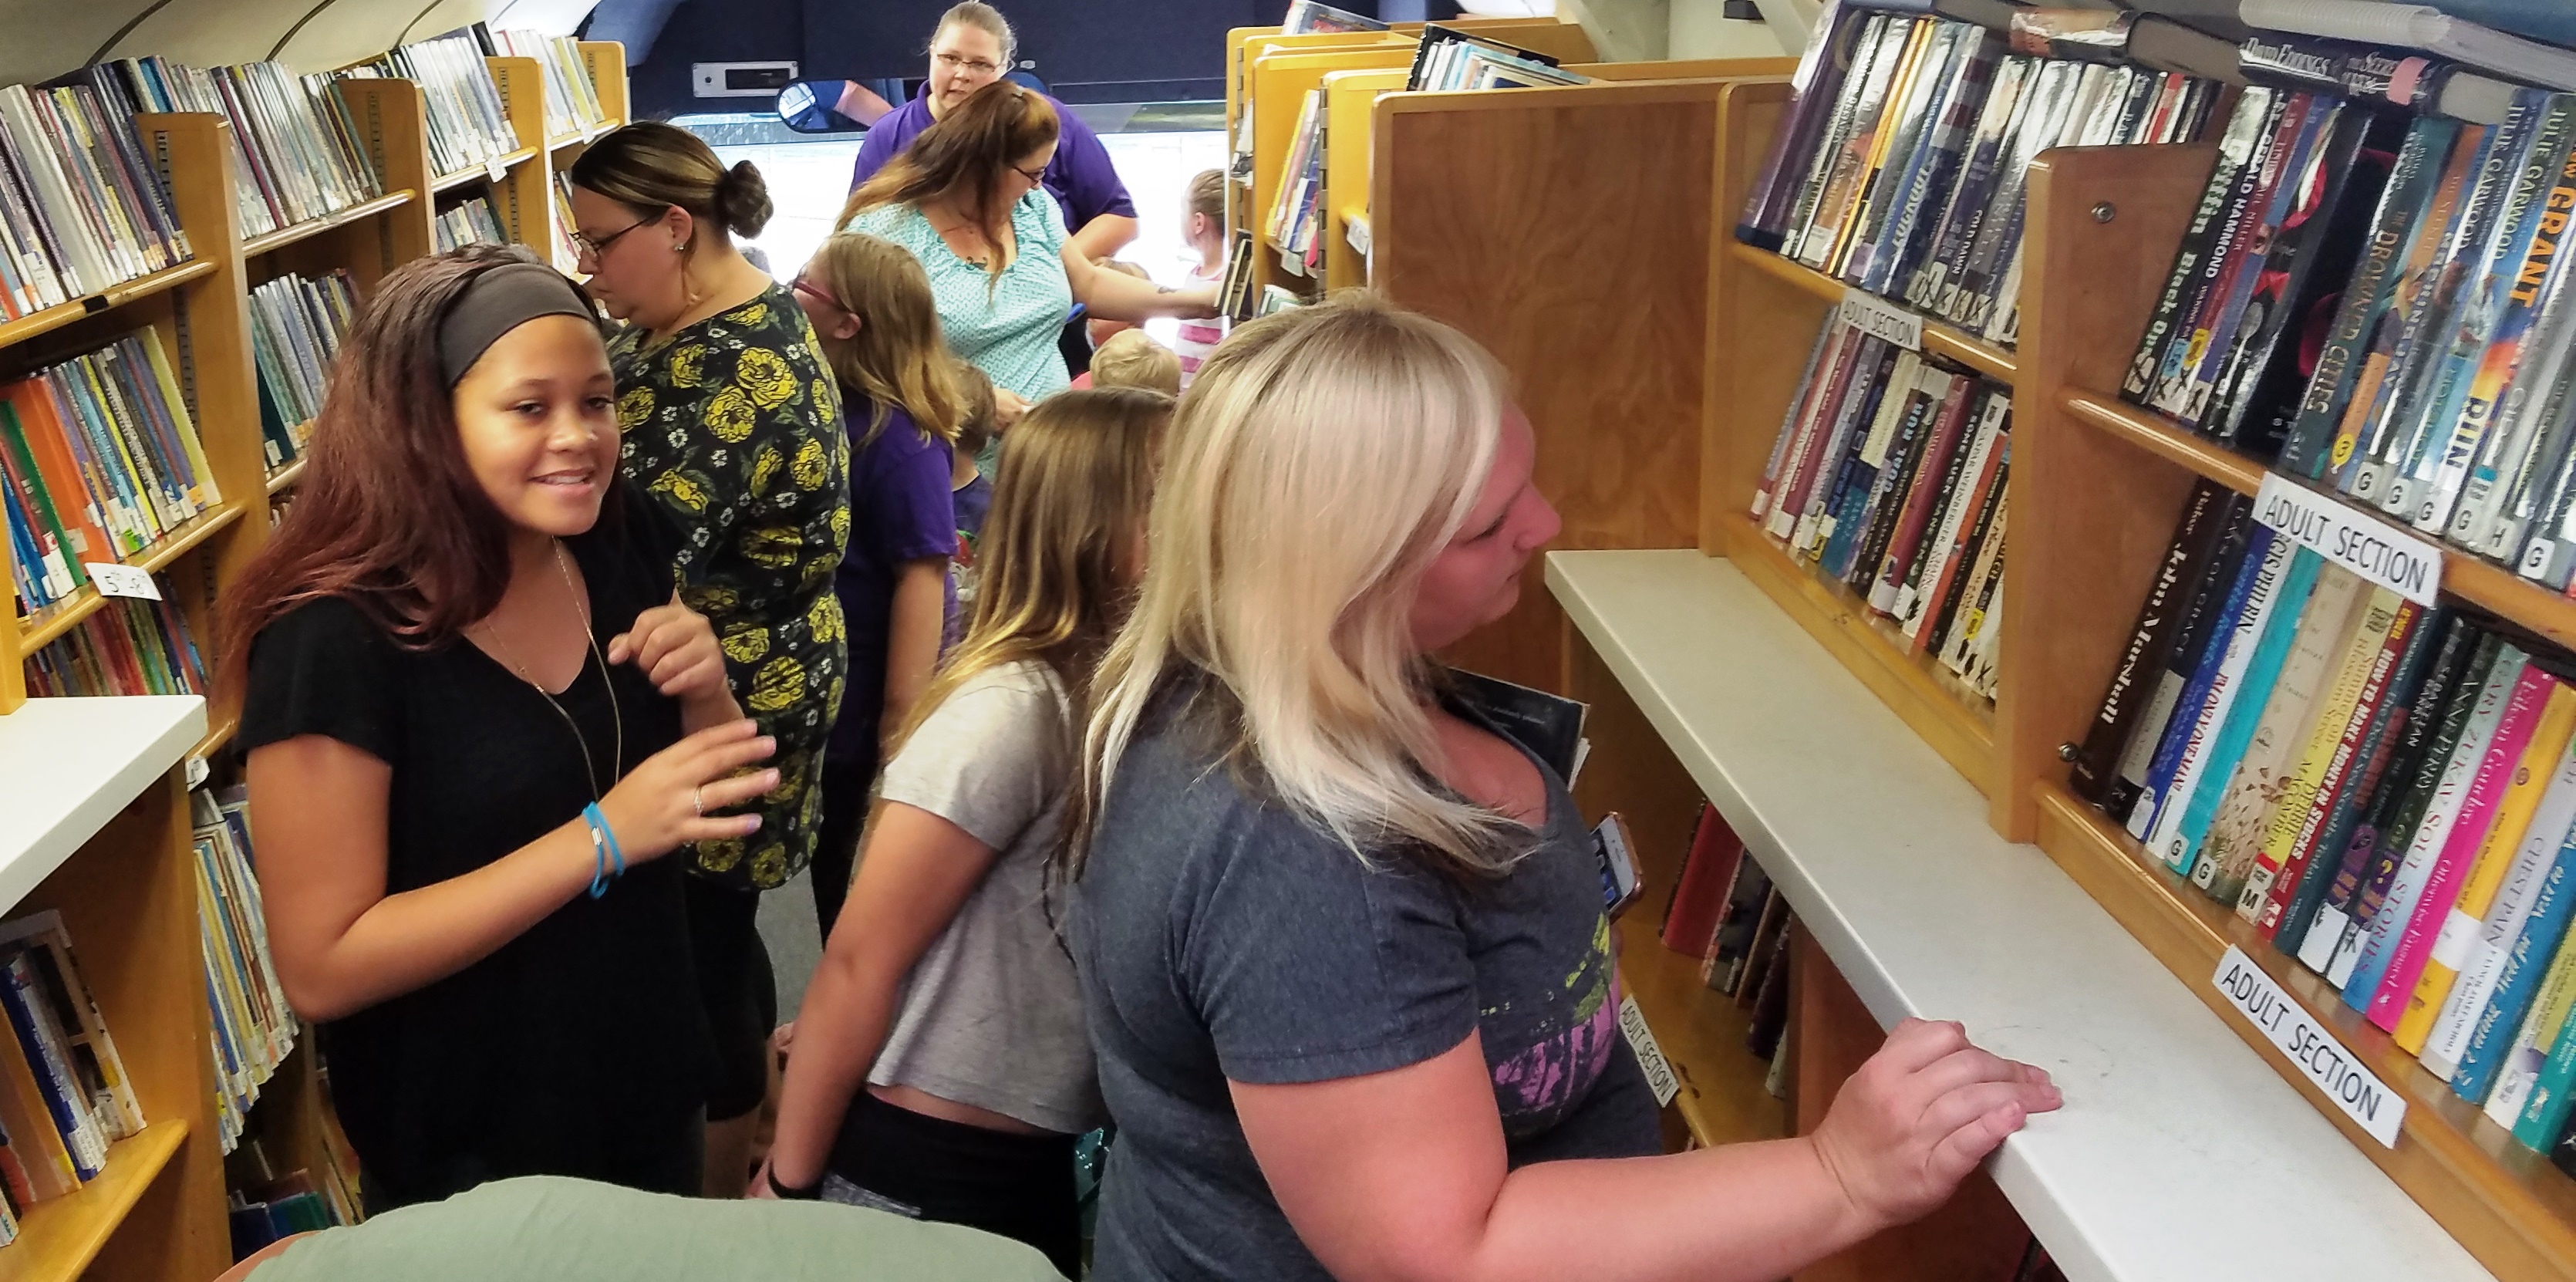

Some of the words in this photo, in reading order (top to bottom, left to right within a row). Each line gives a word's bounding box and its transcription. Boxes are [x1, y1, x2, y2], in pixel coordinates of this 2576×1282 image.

[2493, 100, 2526, 155] JULIE
[2534, 105, 2568, 160] JULIE
[2456, 154, 2504, 253] GARWOOD
[2491, 161, 2544, 263] GARWOOD
[2202, 195, 2247, 280] HAMMOND
[2507, 179, 2576, 309] GRANT
[2158, 248, 2199, 317] Black
[2341, 224, 2399, 343] DROWNED
[1873, 305, 1915, 346] SECTION
[2304, 342, 2350, 419] CITIES
[2444, 393, 2489, 472] RUN
[1941, 456, 1961, 495] LUCK
[2357, 472, 2372, 491] G
[2388, 484, 2402, 504] G
[2418, 501, 2434, 522] G
[2456, 508, 2470, 530] G
[2262, 492, 2331, 546] ADULT
[2334, 525, 2429, 594] SECTION
[2262, 529, 2291, 570] EGIS
[2527, 547, 2543, 569] G
[2150, 541, 2190, 609] John
[2234, 565, 2274, 636] PHILBIN
[2099, 610, 2160, 725] Marshall
[2335, 652, 2374, 724] Summer
[2361, 681, 2378, 704] TO
[2369, 646, 2395, 684] HOW
[2475, 655, 2513, 722] GARY
[2342, 702, 2369, 744] MAKE
[2442, 668, 2479, 736] ANNE
[2325, 722, 2341, 746] on
[2360, 717, 2385, 757] Dead
[2322, 741, 2352, 790] MONEY
[2345, 758, 2366, 791] Sea
[2436, 725, 2481, 807] ZUKAV
[2264, 757, 2312, 850] MACOMBER
[2282, 781, 2318, 842] DEBBIE
[2315, 786, 2331, 808] IN
[2321, 791, 2351, 843] Scrolls
[2168, 838, 2185, 859] G
[2290, 805, 2323, 862] STOCKS
[2404, 808, 2443, 872] SOUL
[2198, 862, 2210, 880] G
[2300, 840, 2328, 886] Today
[2507, 834, 2547, 902] CHEST
[2241, 888, 2261, 910] M
[2355, 878, 2409, 977] STORIES
[1621, 1005, 1645, 1043] ADULT
[1639, 1041, 1673, 1097] SECTION
[2220, 963, 2291, 1033] ADULT
[2288, 1022, 2382, 1123] SECTION
